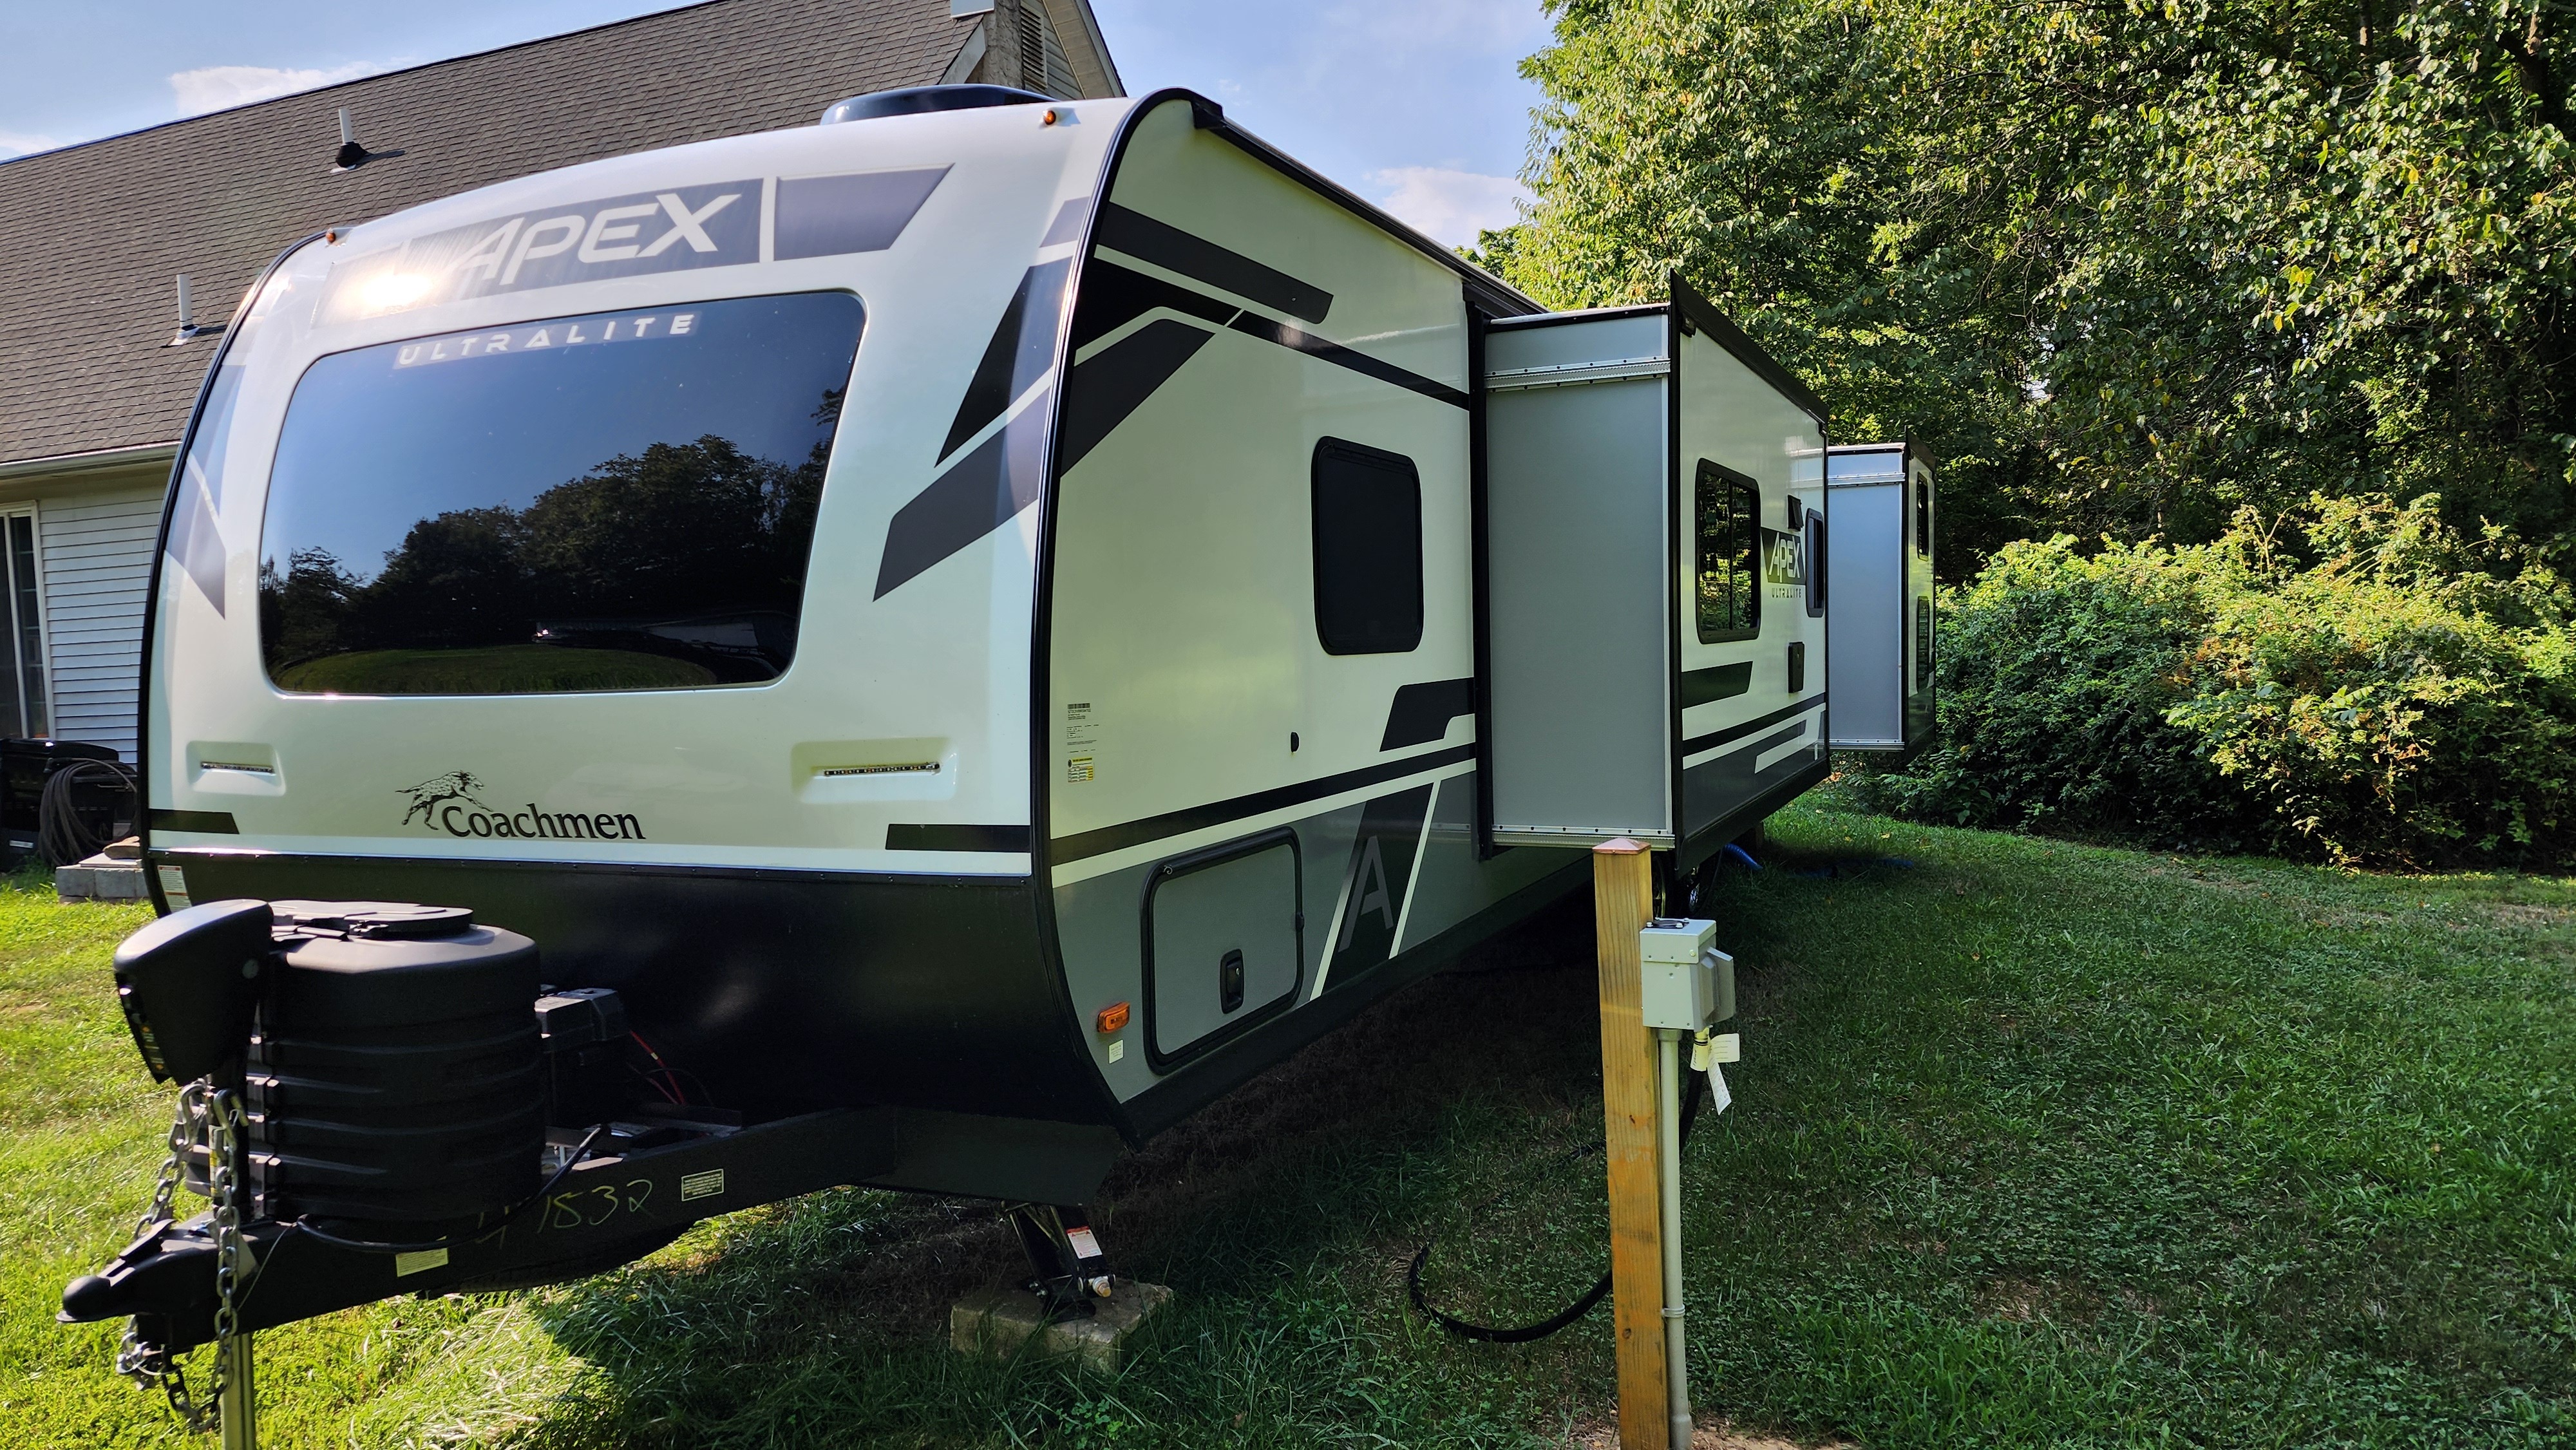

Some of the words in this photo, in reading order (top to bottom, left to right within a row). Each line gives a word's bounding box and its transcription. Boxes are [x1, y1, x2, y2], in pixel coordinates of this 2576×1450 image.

[448, 194, 741, 284] APEX
[399, 314, 695, 365] ULTRALITE
[1769, 532, 1800, 583] APEX
[1772, 588, 1801, 598] ULTRALITE
[441, 804, 646, 840] Coachmen
